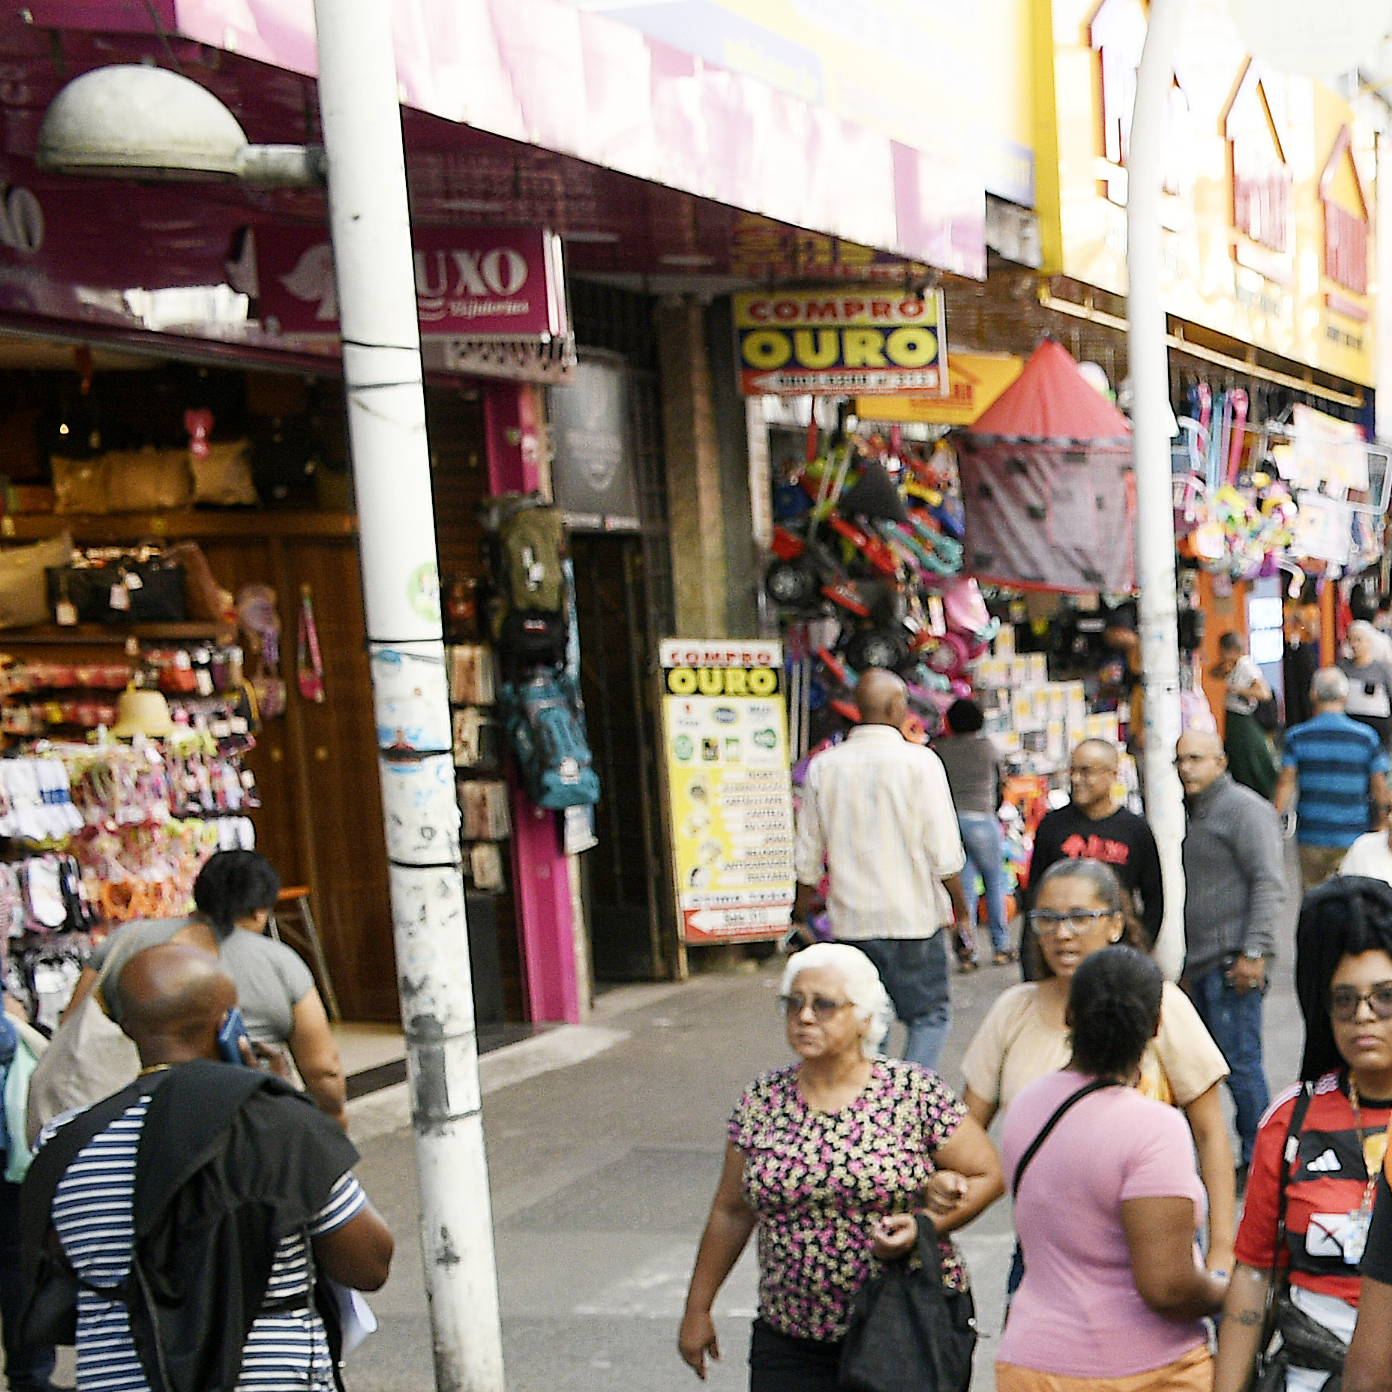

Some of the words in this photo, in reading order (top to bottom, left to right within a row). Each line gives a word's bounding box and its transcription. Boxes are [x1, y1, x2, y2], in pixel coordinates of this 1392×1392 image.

[748, 300, 924, 321] COMPRO
[741, 327, 939, 370] OURO
[671, 652, 772, 666] COMPRO
[668, 667, 778, 696] OURO
